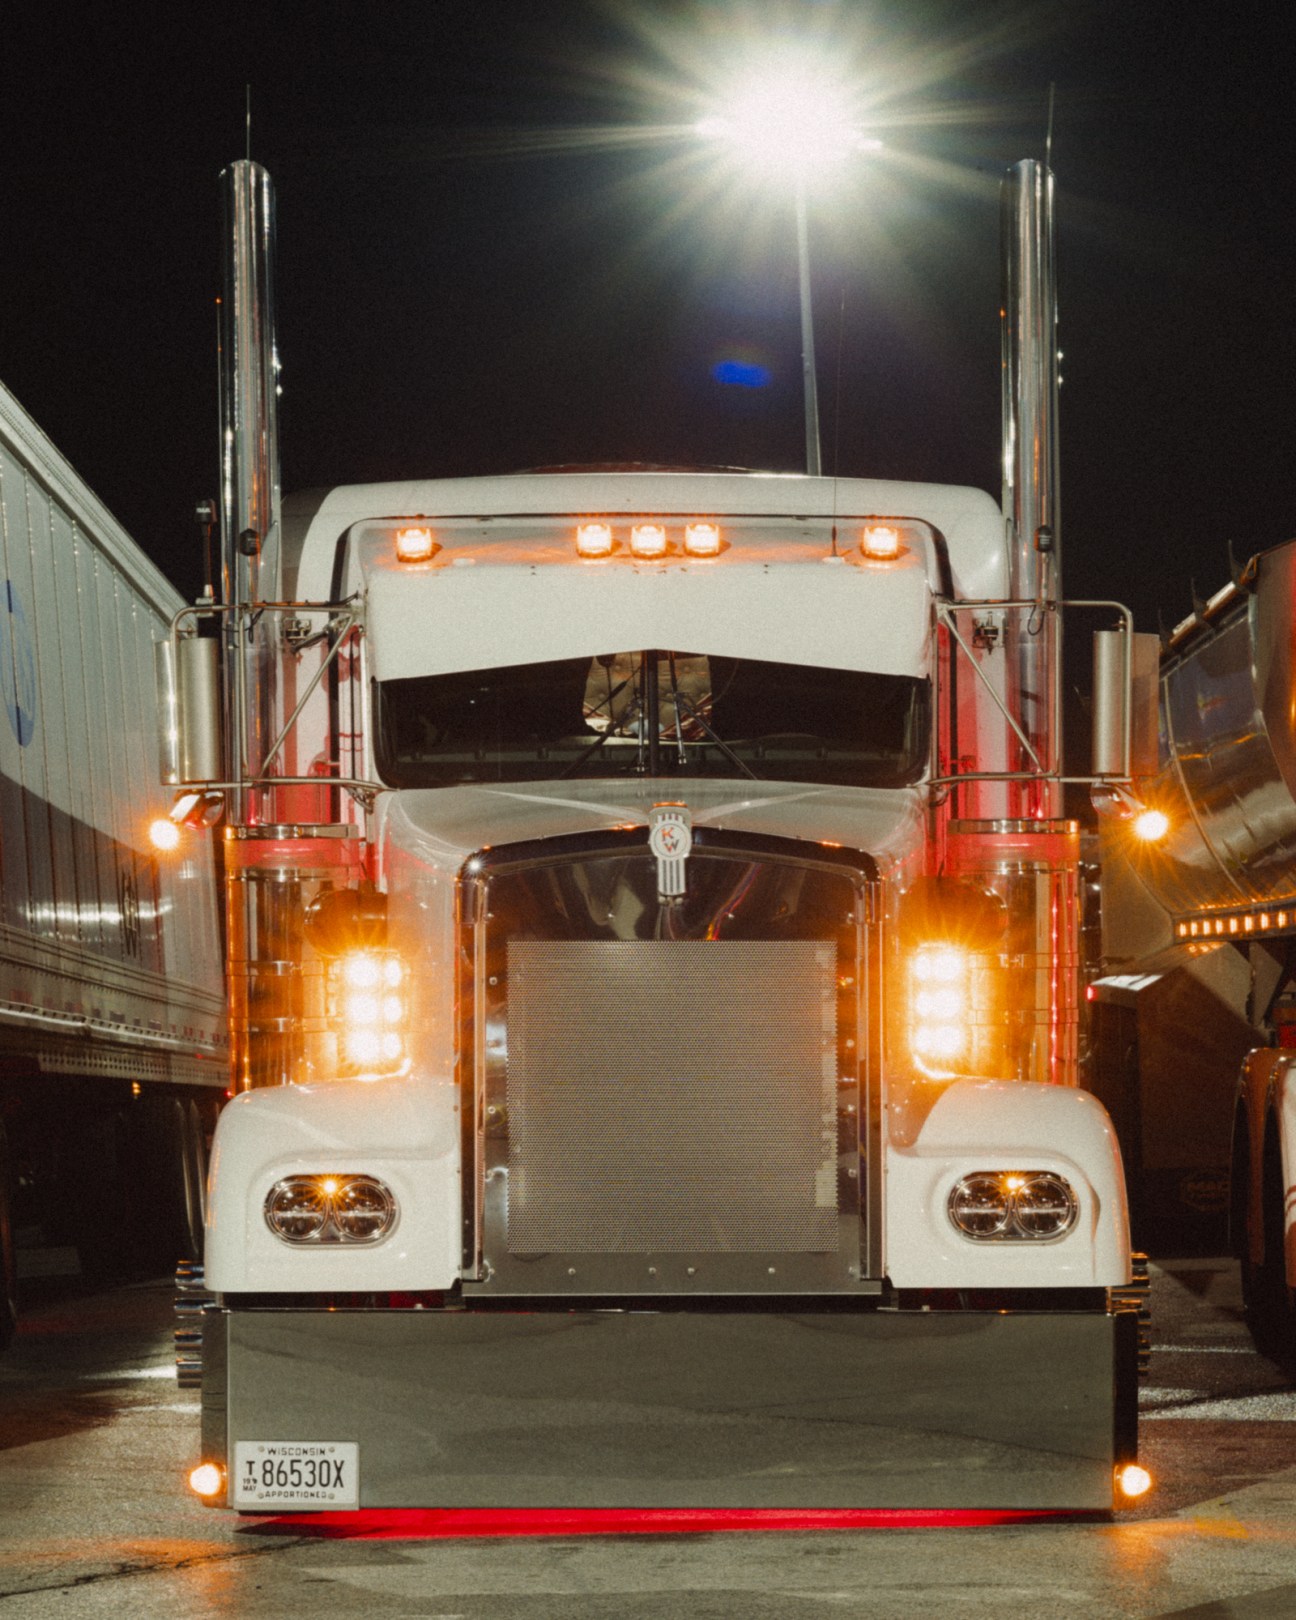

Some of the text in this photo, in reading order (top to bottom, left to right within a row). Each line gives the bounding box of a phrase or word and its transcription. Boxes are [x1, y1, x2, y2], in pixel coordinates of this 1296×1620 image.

[267, 1448, 326, 1456] WISCONSIN
[246, 1459, 345, 1488] T 86530X
[265, 1491, 327, 1499] APPORTIONED
